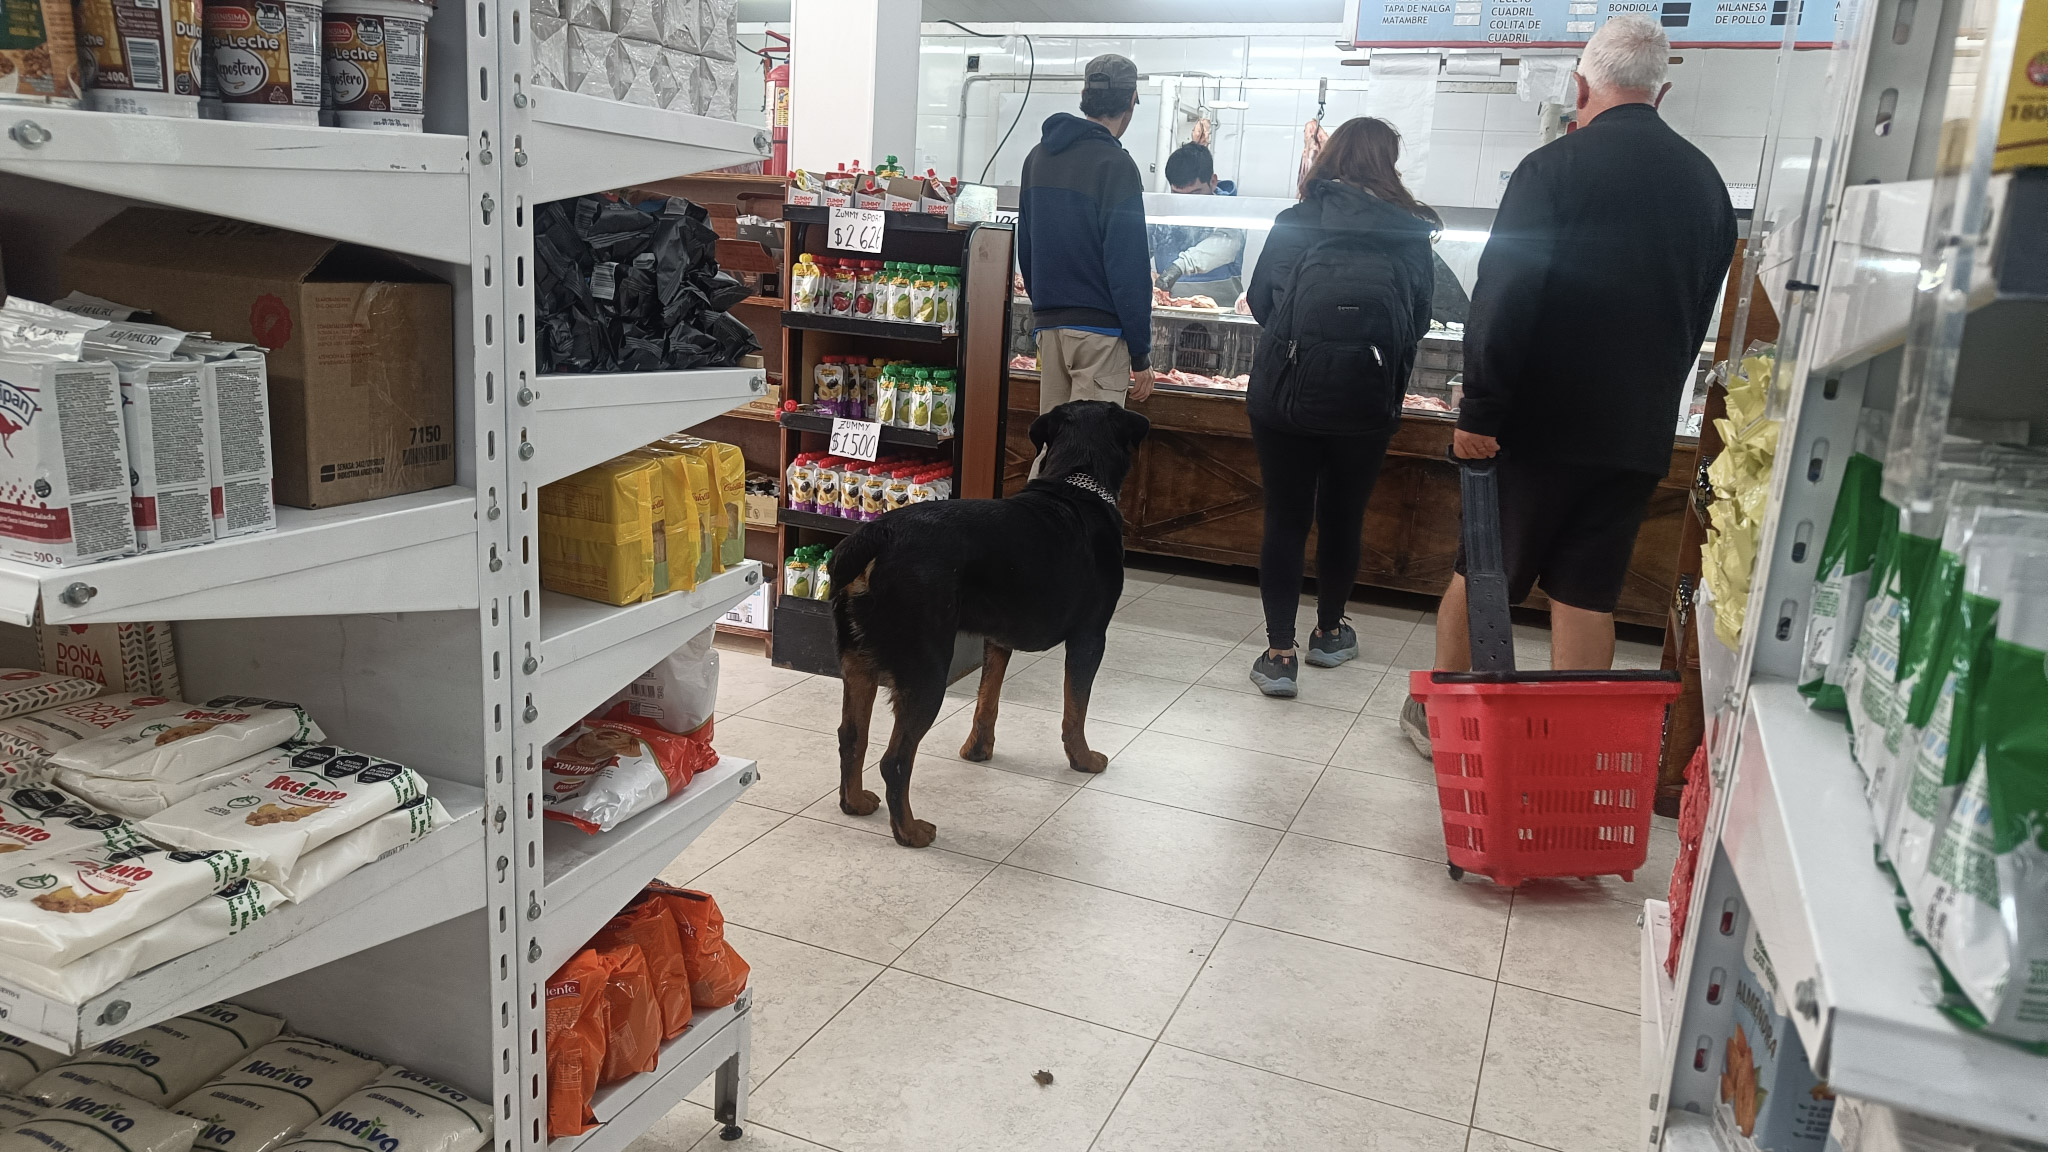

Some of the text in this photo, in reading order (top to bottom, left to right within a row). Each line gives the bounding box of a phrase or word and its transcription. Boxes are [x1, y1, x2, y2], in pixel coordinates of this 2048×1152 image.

[1384, 5, 1451, 13] TAPA DE NALGA
[1491, 8, 1534, 17] CUADRIL
[1608, 3, 1659, 12] BONDIOLA
[1717, 3, 1767, 12] MILANESA
[1382, 16, 1428, 24] MATAMBRE
[1489, 20, 1542, 30] COLITA DE
[1715, 15, 1766, 24] DE POLLO
[228, 34, 279, 50] Leche
[1488, 33, 1531, 43] CUADRIL
[335, 48, 378, 60] Leche
[105, 329, 163, 346] AB/MAURI
[837, 420, 871, 431] ZUMMY
[409, 425, 441, 445] 7150
[830, 432, 876, 458] $1.500
[337, 465, 384, 480] INDUSTRIA ARGENTINA
[33, 550, 53, 563] 500
[56, 642, 103, 667] DOÑA
[57, 705, 120, 730] FLORA
[82, 701, 136, 722] DOÑA
[1735, 979, 1778, 1062] ALMENDRA
[98, 1038, 161, 1068] Nativa
[240, 1060, 314, 1090] Nativa
[56, 1095, 135, 1134] Nativa
[402, 1105, 417, 1116] TIPO
[321, 1109, 399, 1152] Nativa
